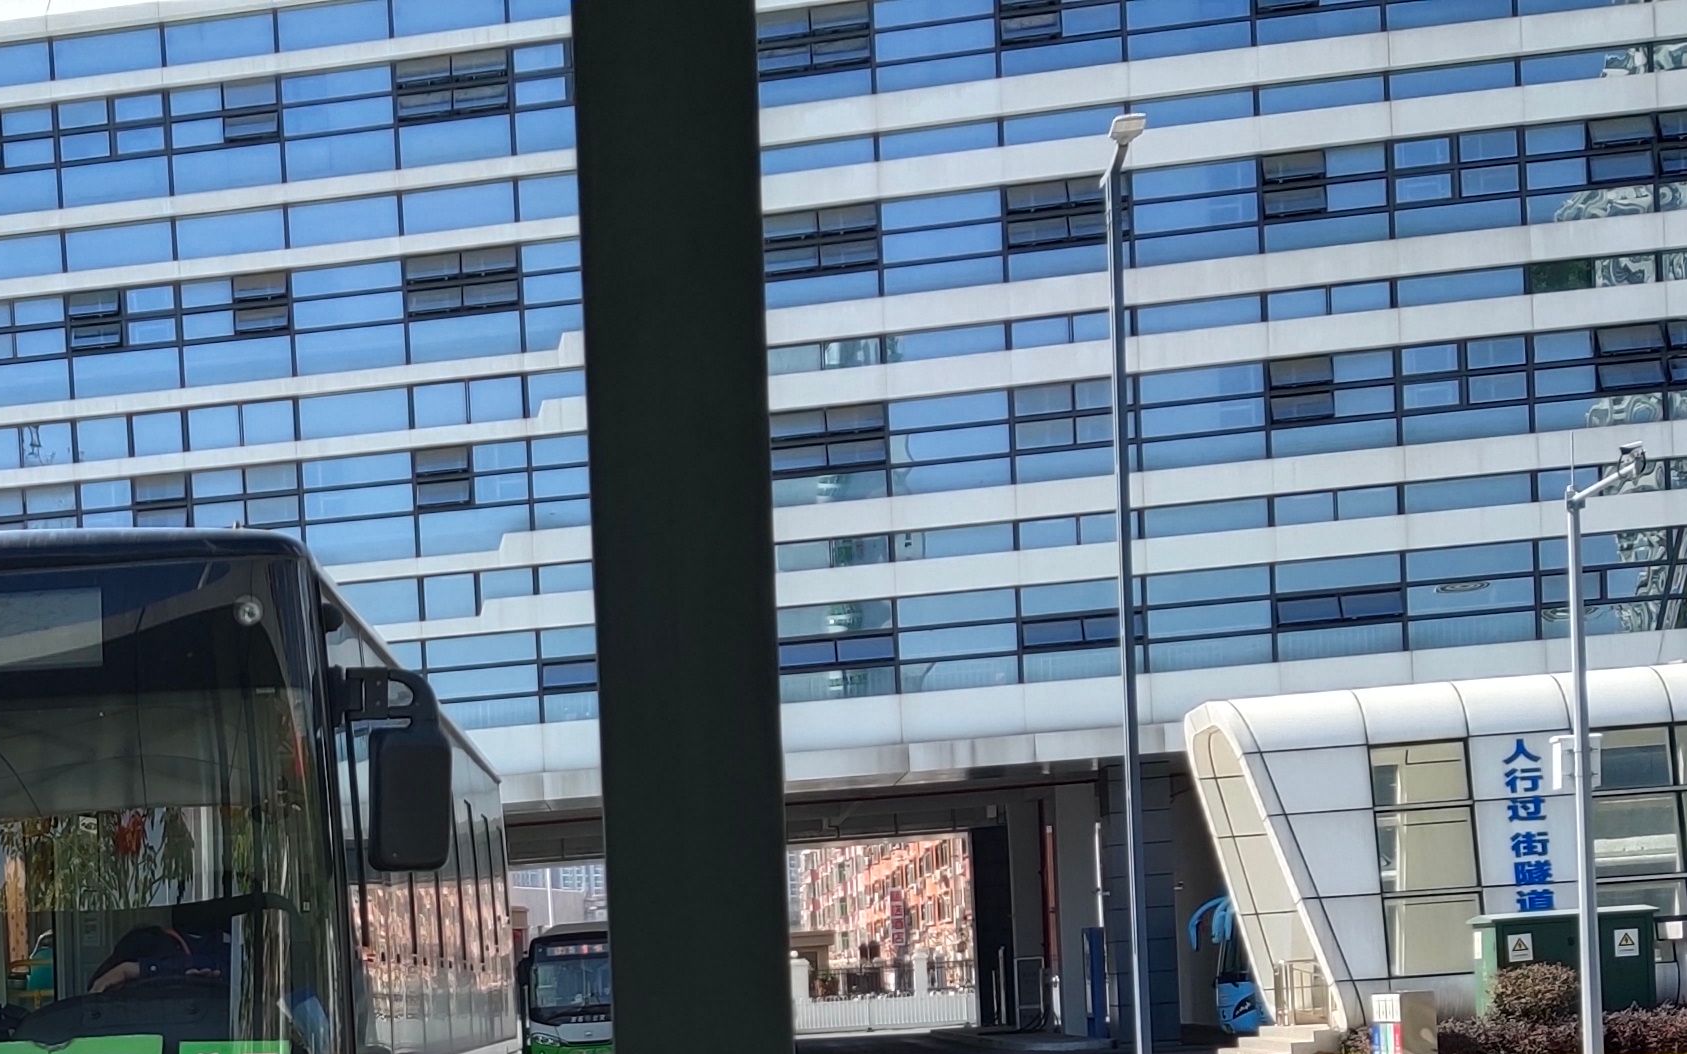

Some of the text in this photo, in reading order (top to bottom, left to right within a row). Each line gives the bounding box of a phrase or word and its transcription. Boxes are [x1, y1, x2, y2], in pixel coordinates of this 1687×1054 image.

[1502, 738, 1555, 913] 人行过街隧道
